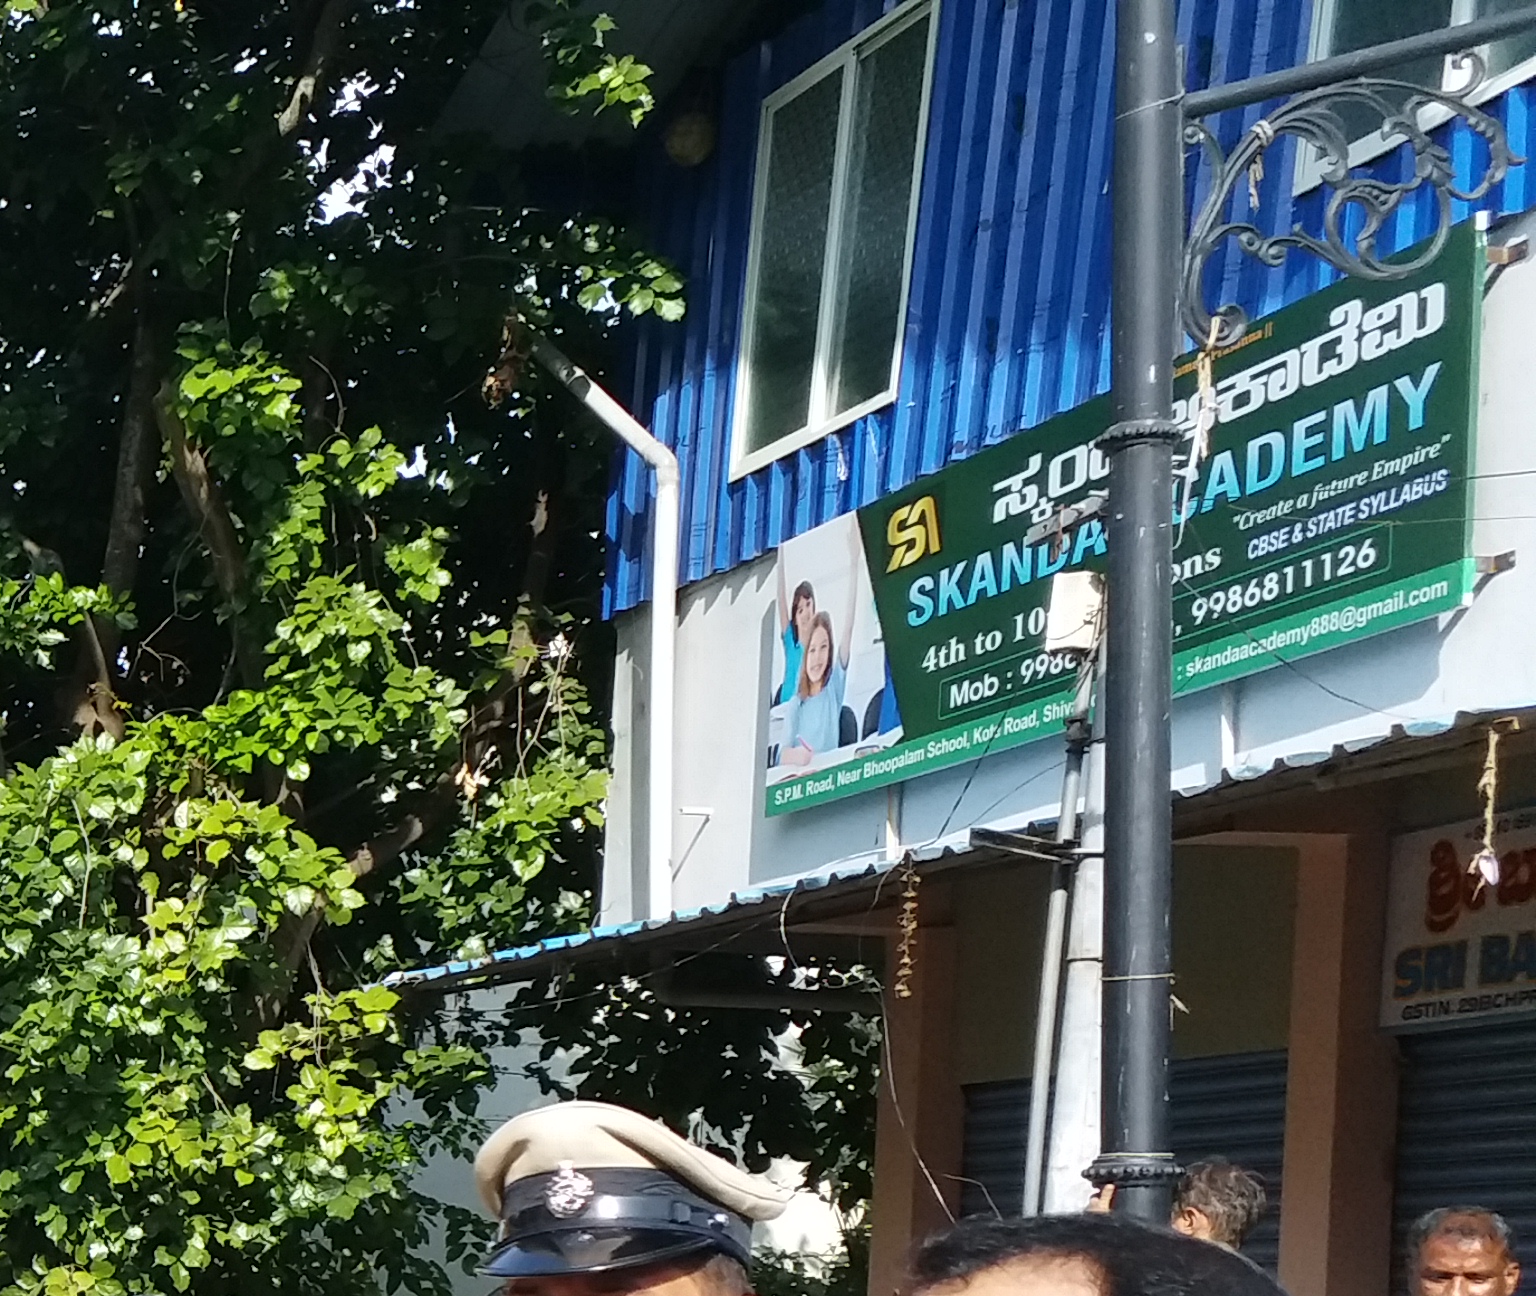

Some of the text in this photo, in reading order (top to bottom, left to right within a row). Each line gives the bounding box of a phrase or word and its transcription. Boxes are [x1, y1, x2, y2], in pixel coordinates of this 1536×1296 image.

[1247, 468, 1450, 560] CBSE & STATE SYLLABUS
[1309, 472, 1368, 509] future
[1190, 538, 1377, 627] 9986811126
[921, 636, 967, 673] 4th
[974, 630, 1003, 655] to
[1185, 579, 1449, 678] skandaacademy888@gmail.com
[949, 673, 999, 708] Mob
[837, 769, 861, 787] Near
[863, 750, 925, 779] Bhoopalam
[927, 736, 971, 759] School,
[1003, 710, 1040, 736] Road,
